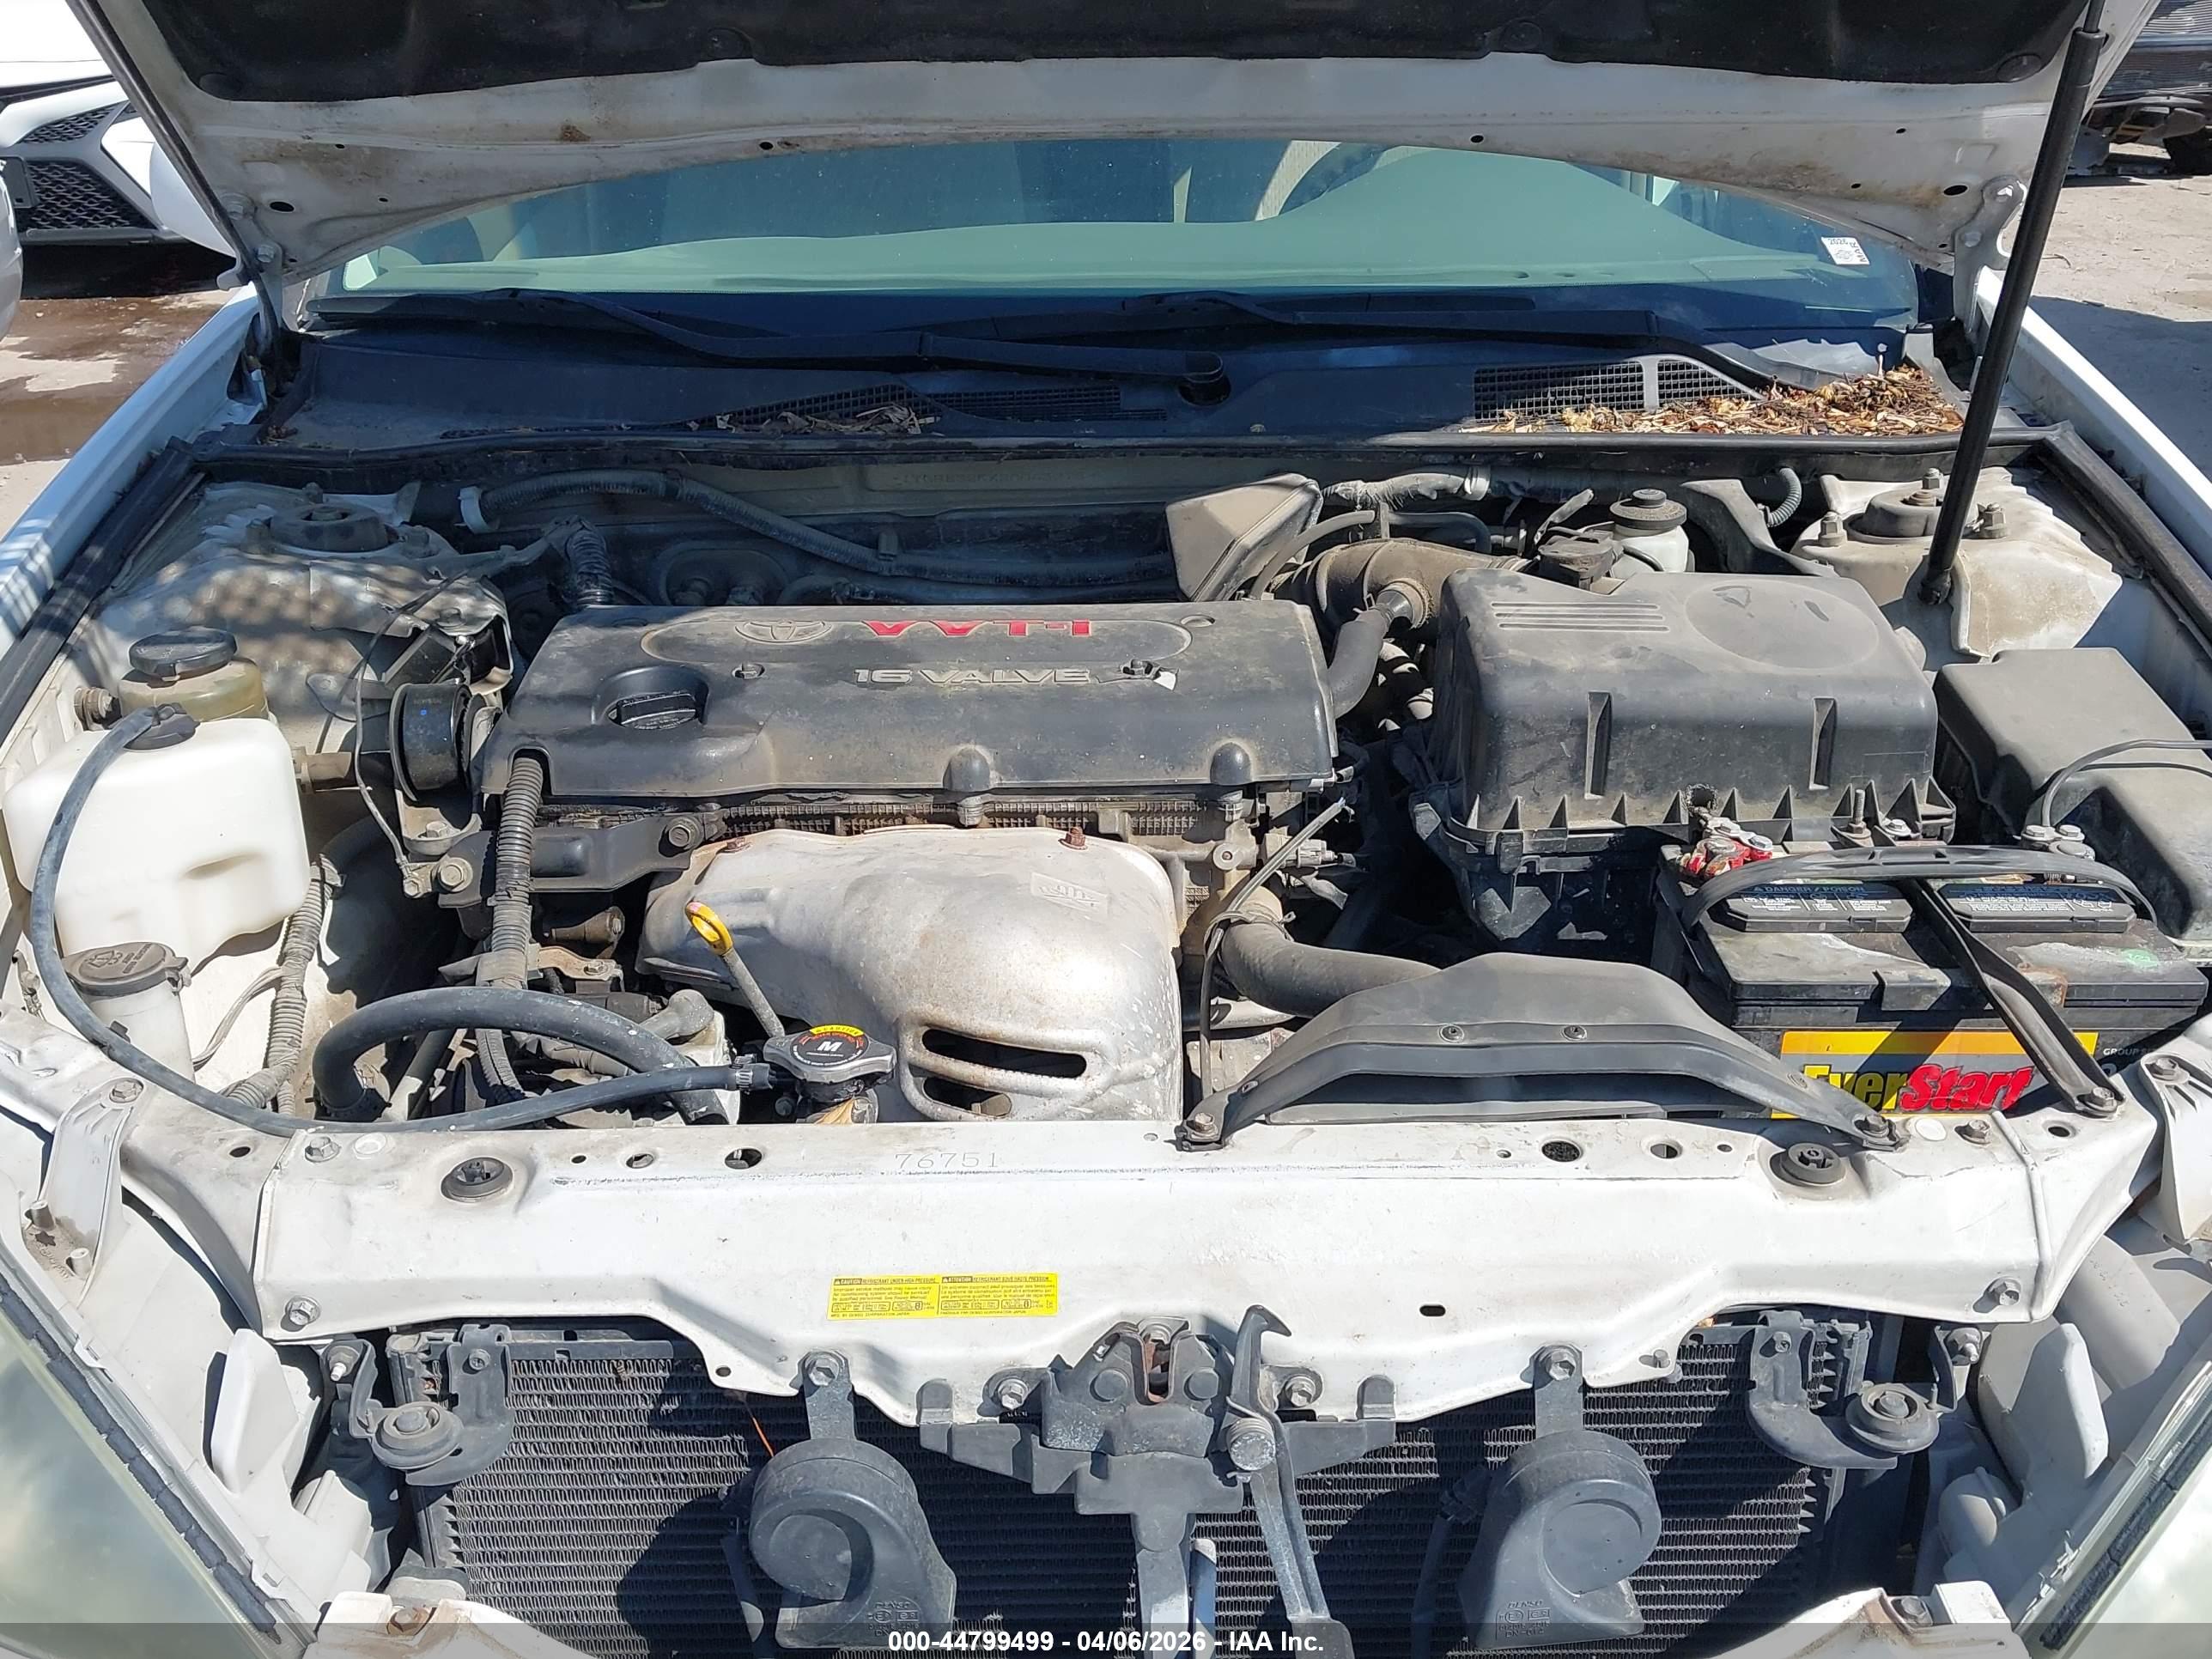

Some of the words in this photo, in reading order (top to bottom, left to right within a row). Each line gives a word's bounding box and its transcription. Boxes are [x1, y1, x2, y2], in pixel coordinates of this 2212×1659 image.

[854, 669, 913, 684] 16
[918, 669, 1091, 684] VALVE
[817, 1041, 843, 1052] M
[895, 1152, 999, 1169] 76751
[1507, 1599, 1544, 1609] DENSO
